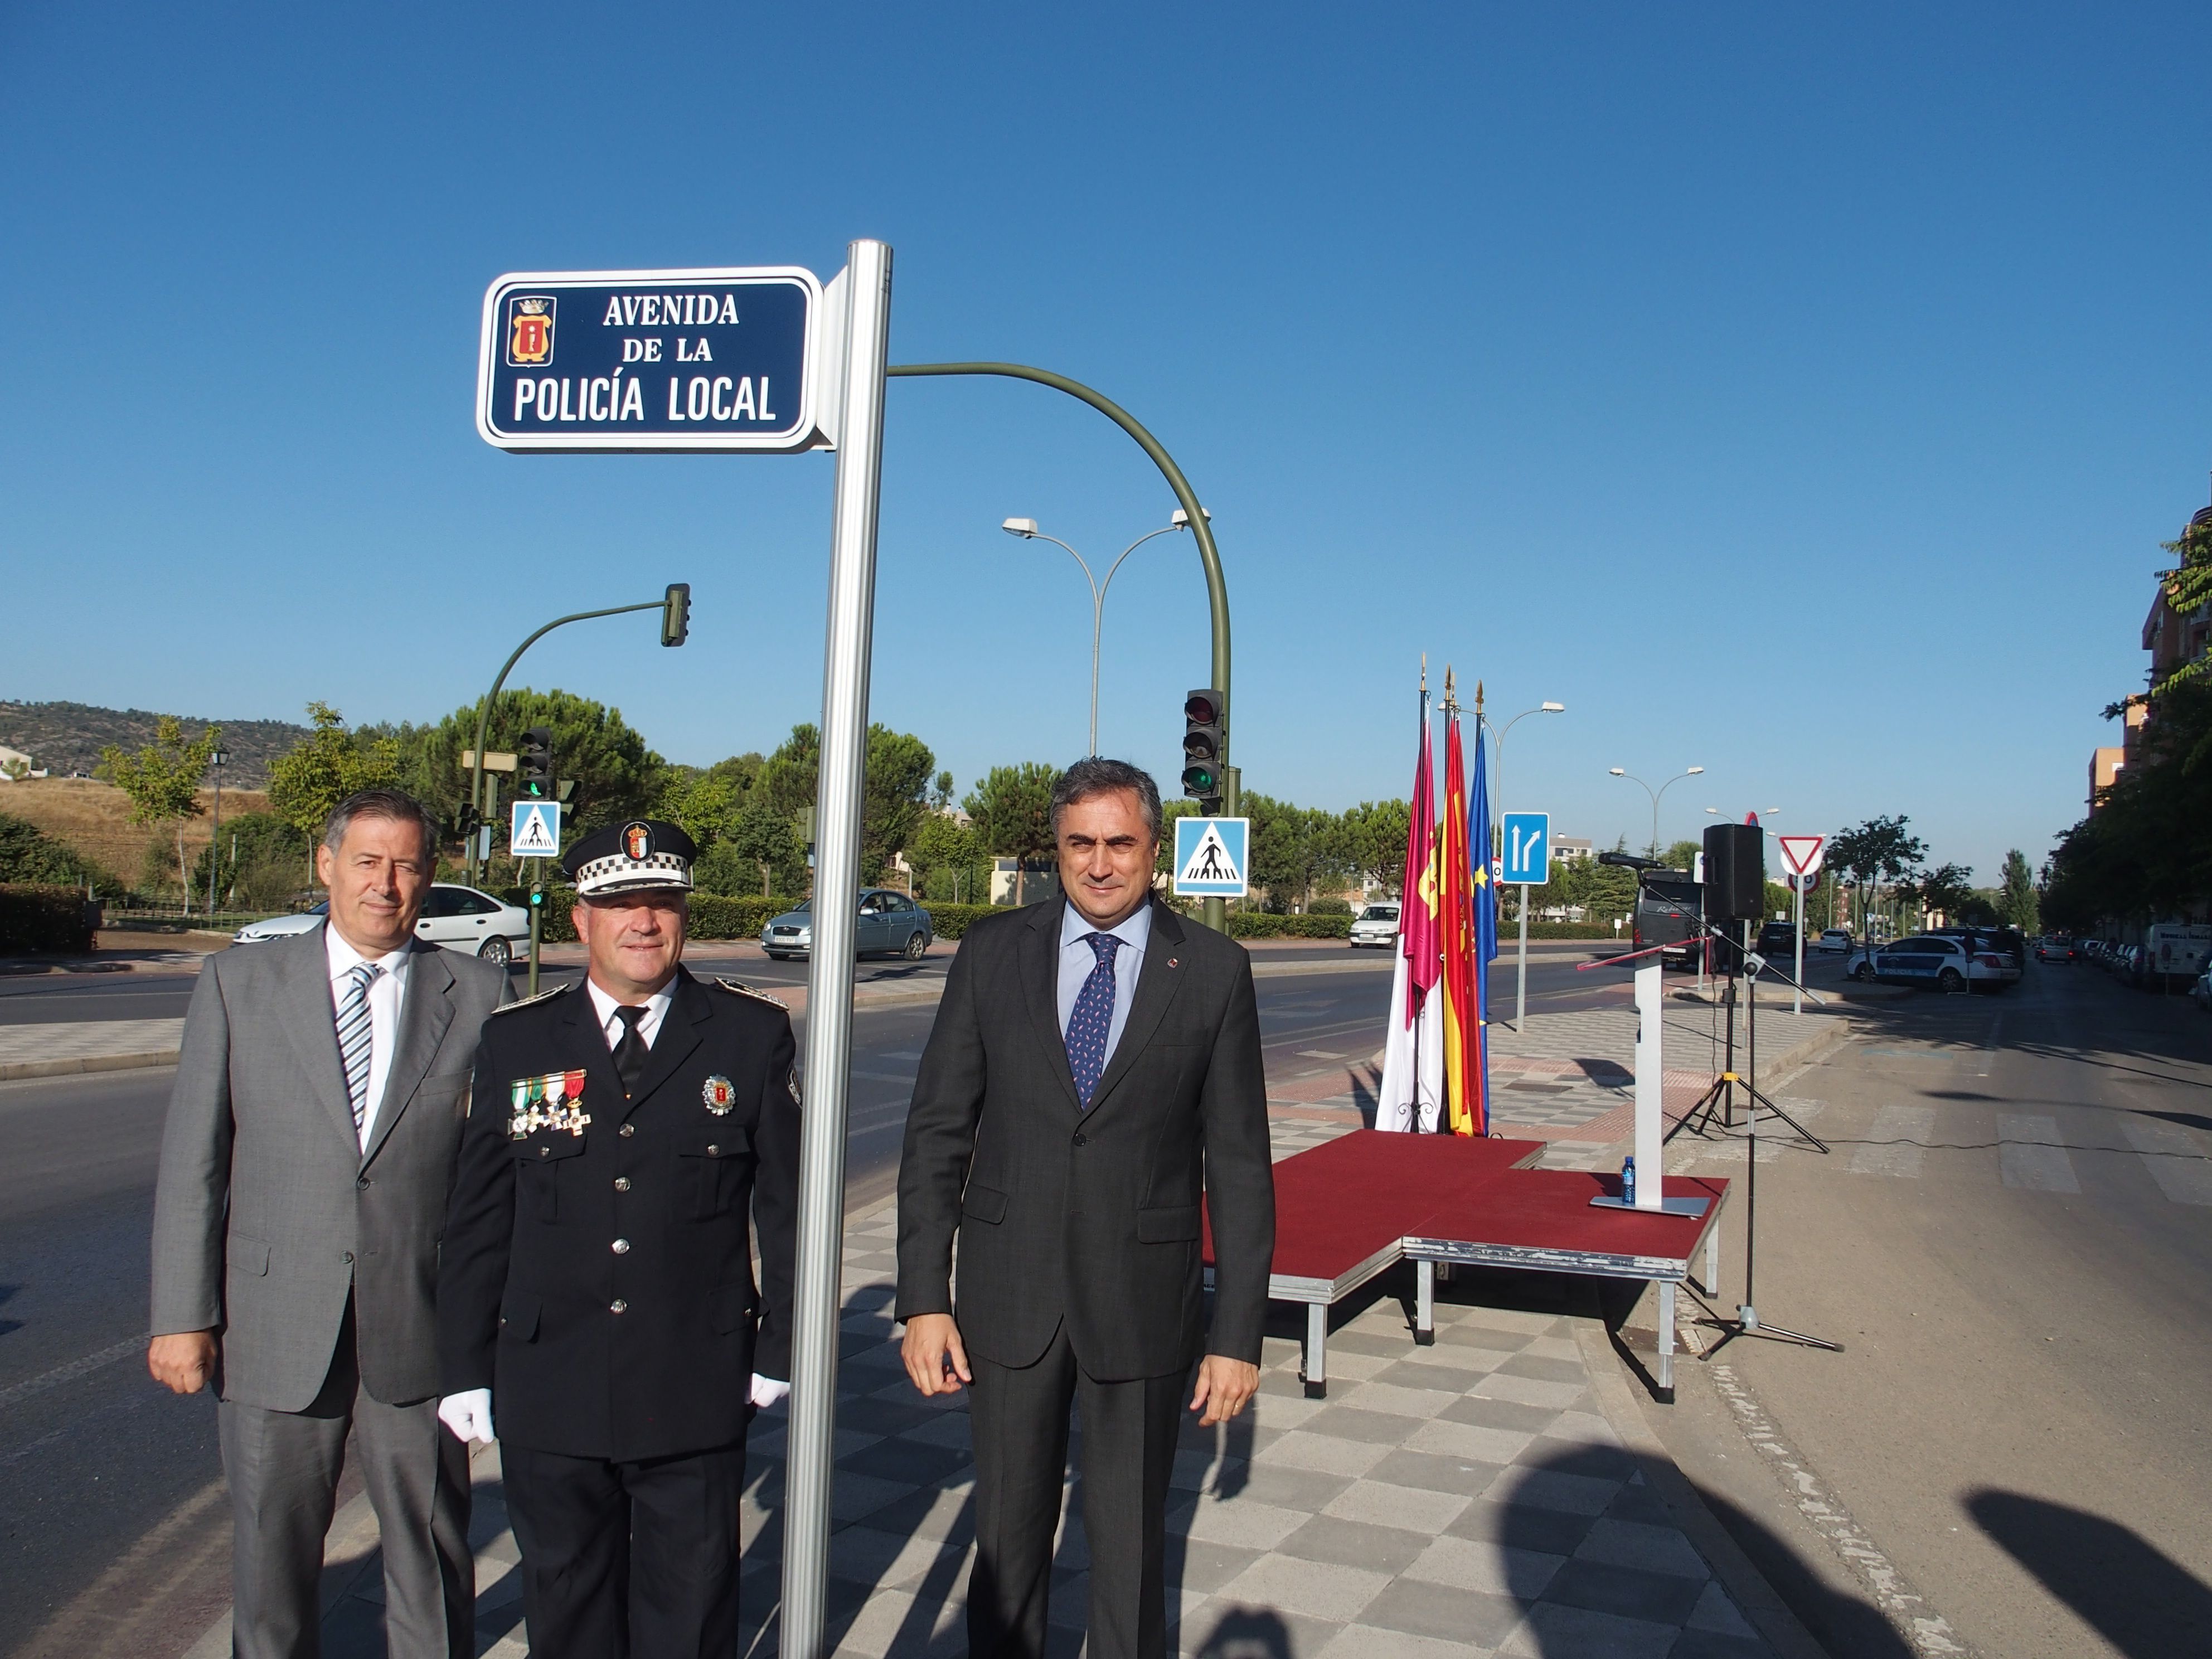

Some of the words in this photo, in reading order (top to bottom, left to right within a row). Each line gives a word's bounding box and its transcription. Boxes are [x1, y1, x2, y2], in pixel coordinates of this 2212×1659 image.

[603, 294, 739, 326] AVENIDA
[623, 339, 662, 362] DE
[677, 338, 712, 361] LA
[515, 366, 644, 421] POLICÍA
[669, 377, 775, 420] LOCAL
[1494, 867, 1501, 876] 0
